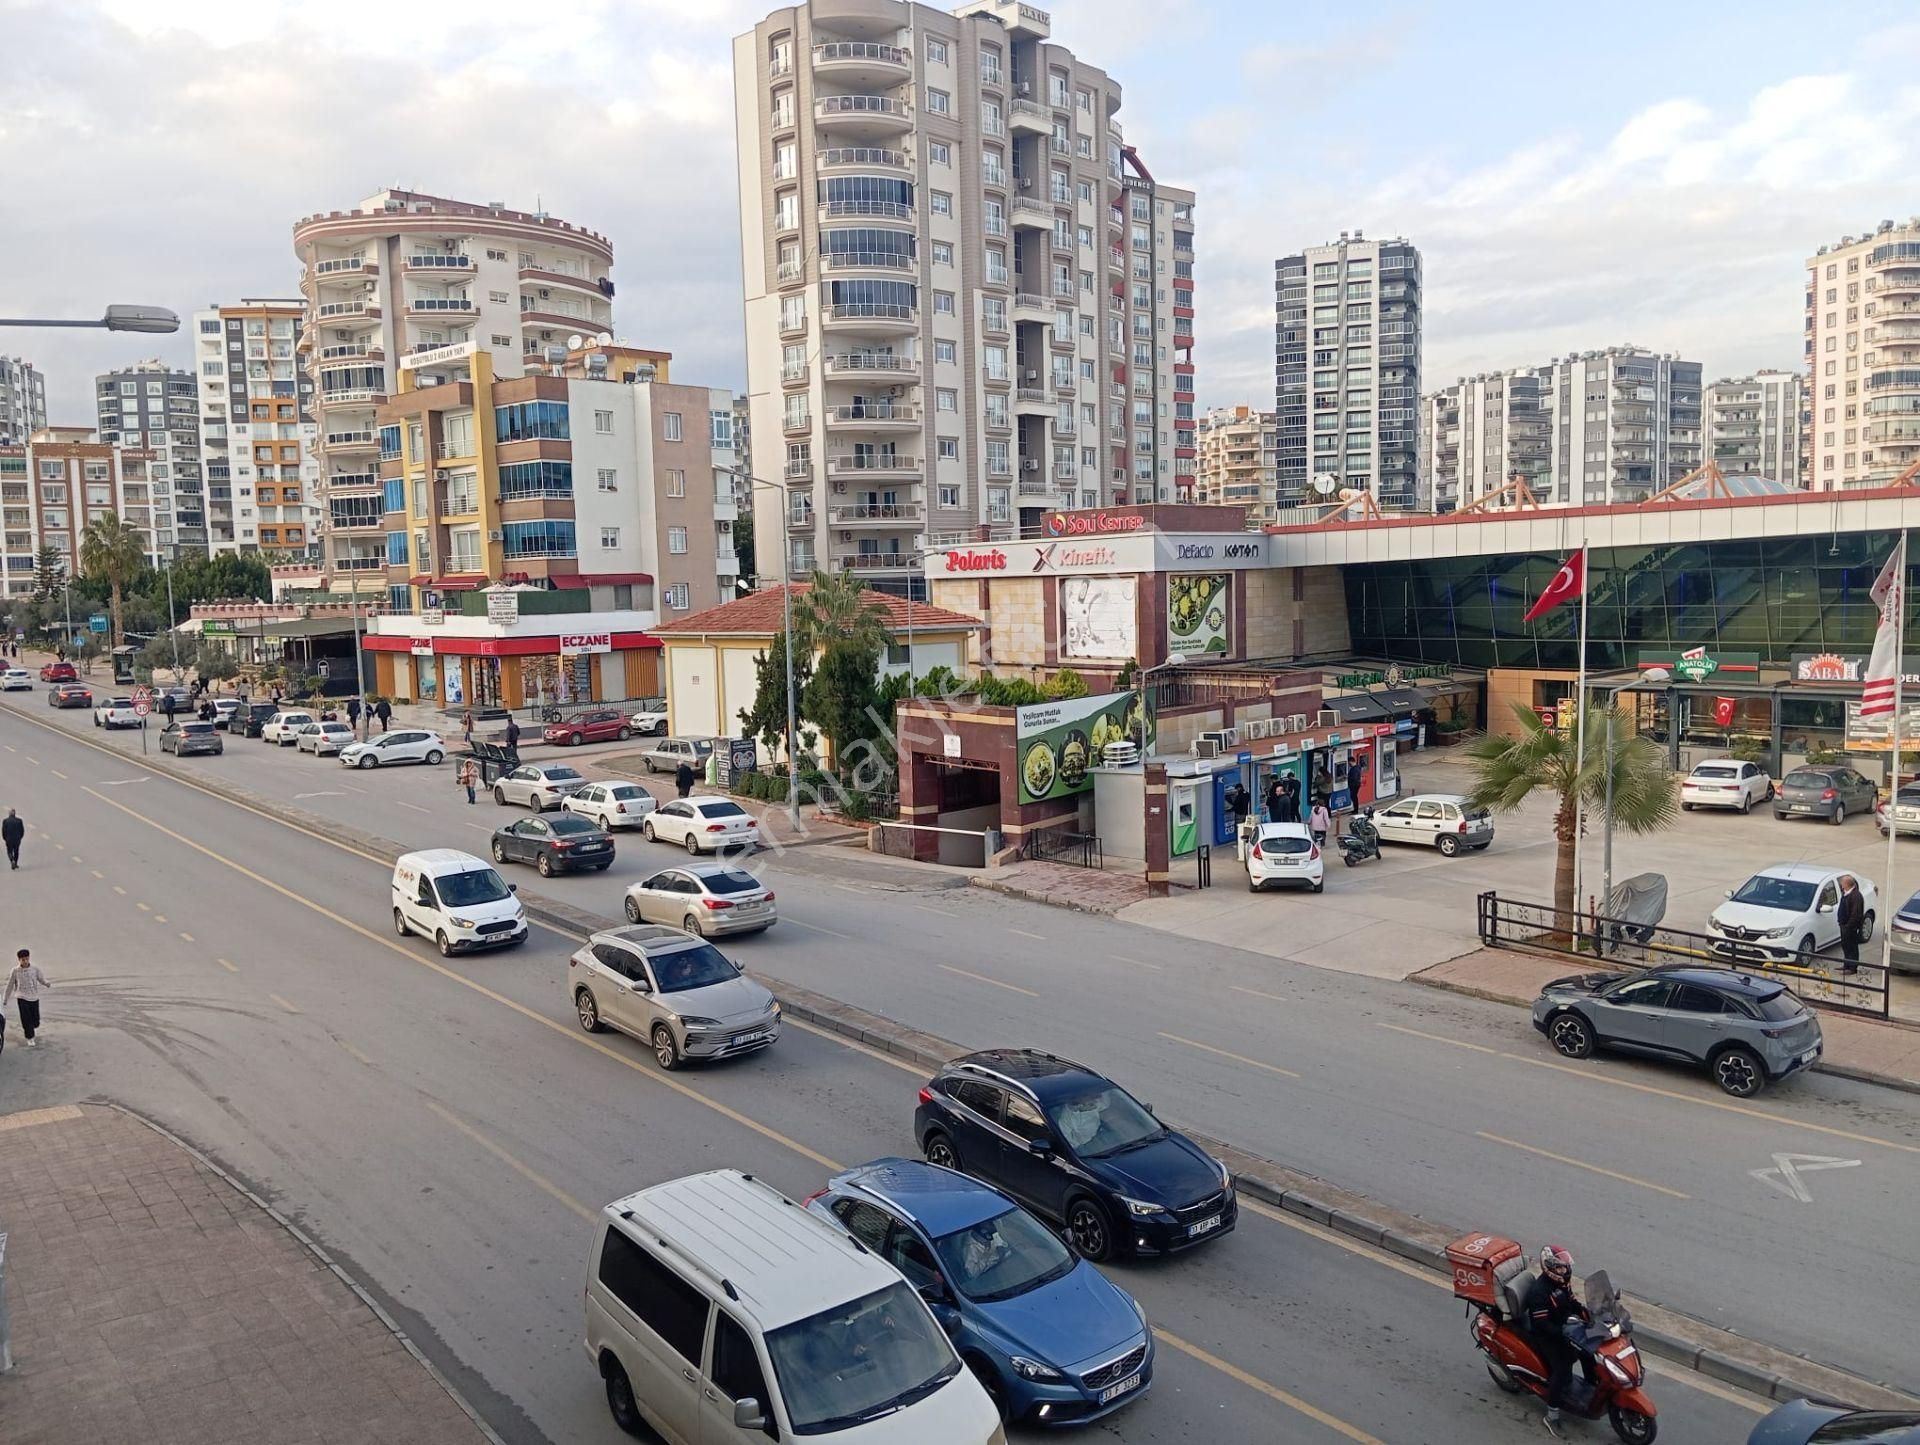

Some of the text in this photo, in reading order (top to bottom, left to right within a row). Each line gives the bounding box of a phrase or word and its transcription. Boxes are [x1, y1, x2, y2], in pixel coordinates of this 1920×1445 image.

[1097, 513, 1144, 531] CENTER
[946, 549, 1007, 571] Polaris
[562, 634, 609, 648] ECZANE
[1797, 659, 1859, 681] SABAH
